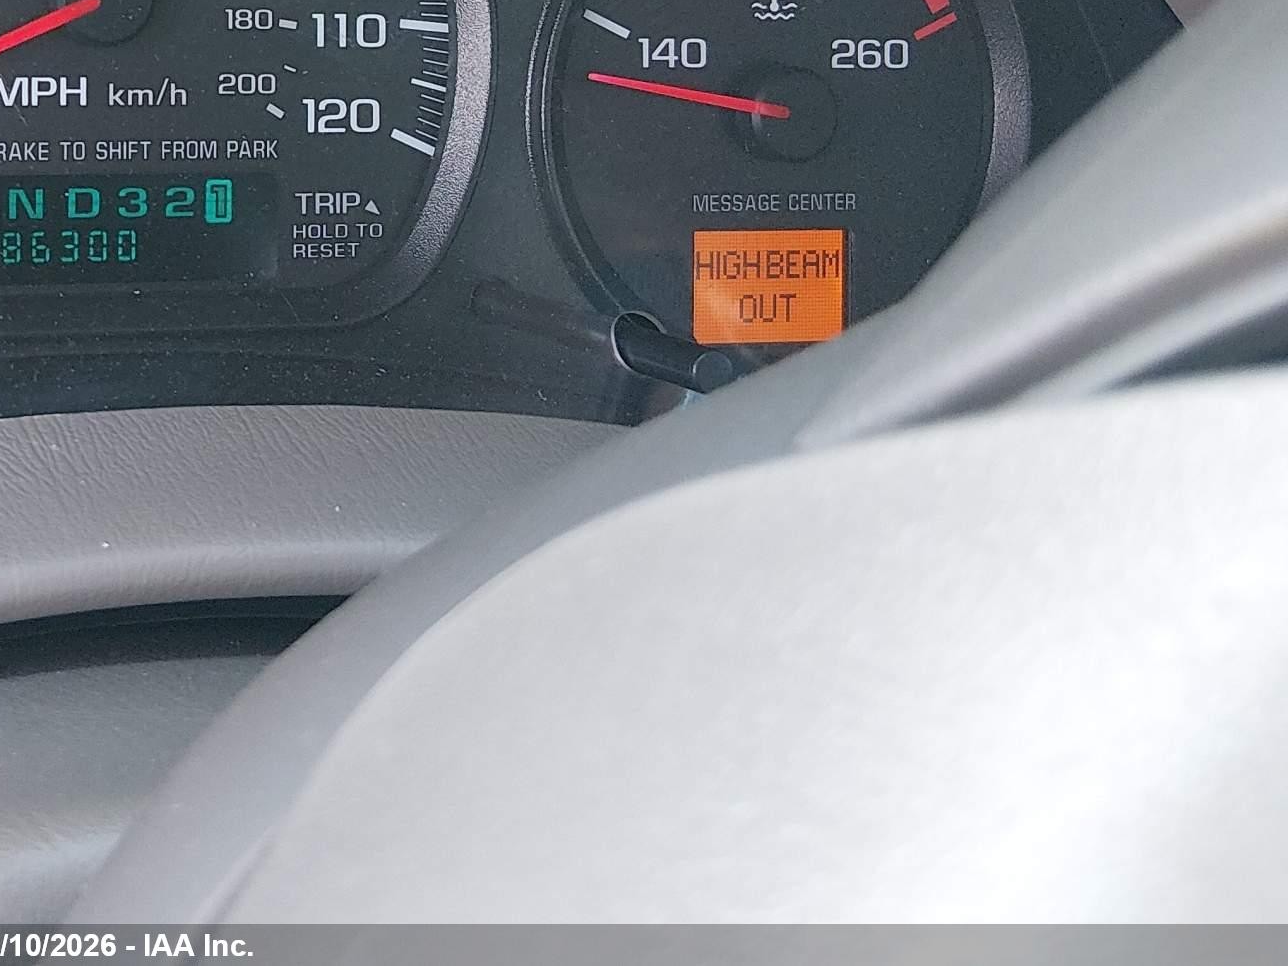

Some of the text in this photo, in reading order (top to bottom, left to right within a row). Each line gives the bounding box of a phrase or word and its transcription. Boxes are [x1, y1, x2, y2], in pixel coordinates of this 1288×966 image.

[225, 9, 272, 29] 180
[312, 14, 386, 47] 110
[639, 39, 706, 67] 140
[832, 40, 908, 68] 260
[109, 78, 186, 105] km/h
[219, 74, 275, 94] 200
[303, 99, 379, 132] 120
[60, 142, 85, 160] TO
[96, 141, 151, 159] SHIFT
[162, 141, 216, 159] FROM
[227, 140, 277, 158] PARK
[295, 193, 360, 214] TRIP
[694, 193, 855, 212] MESSAGE CENTER
[294, 224, 382, 238] HOLD TO
[3, 230, 137, 264] 86300
[294, 243, 359, 258] RESET
[740, 293, 796, 322] OUT
